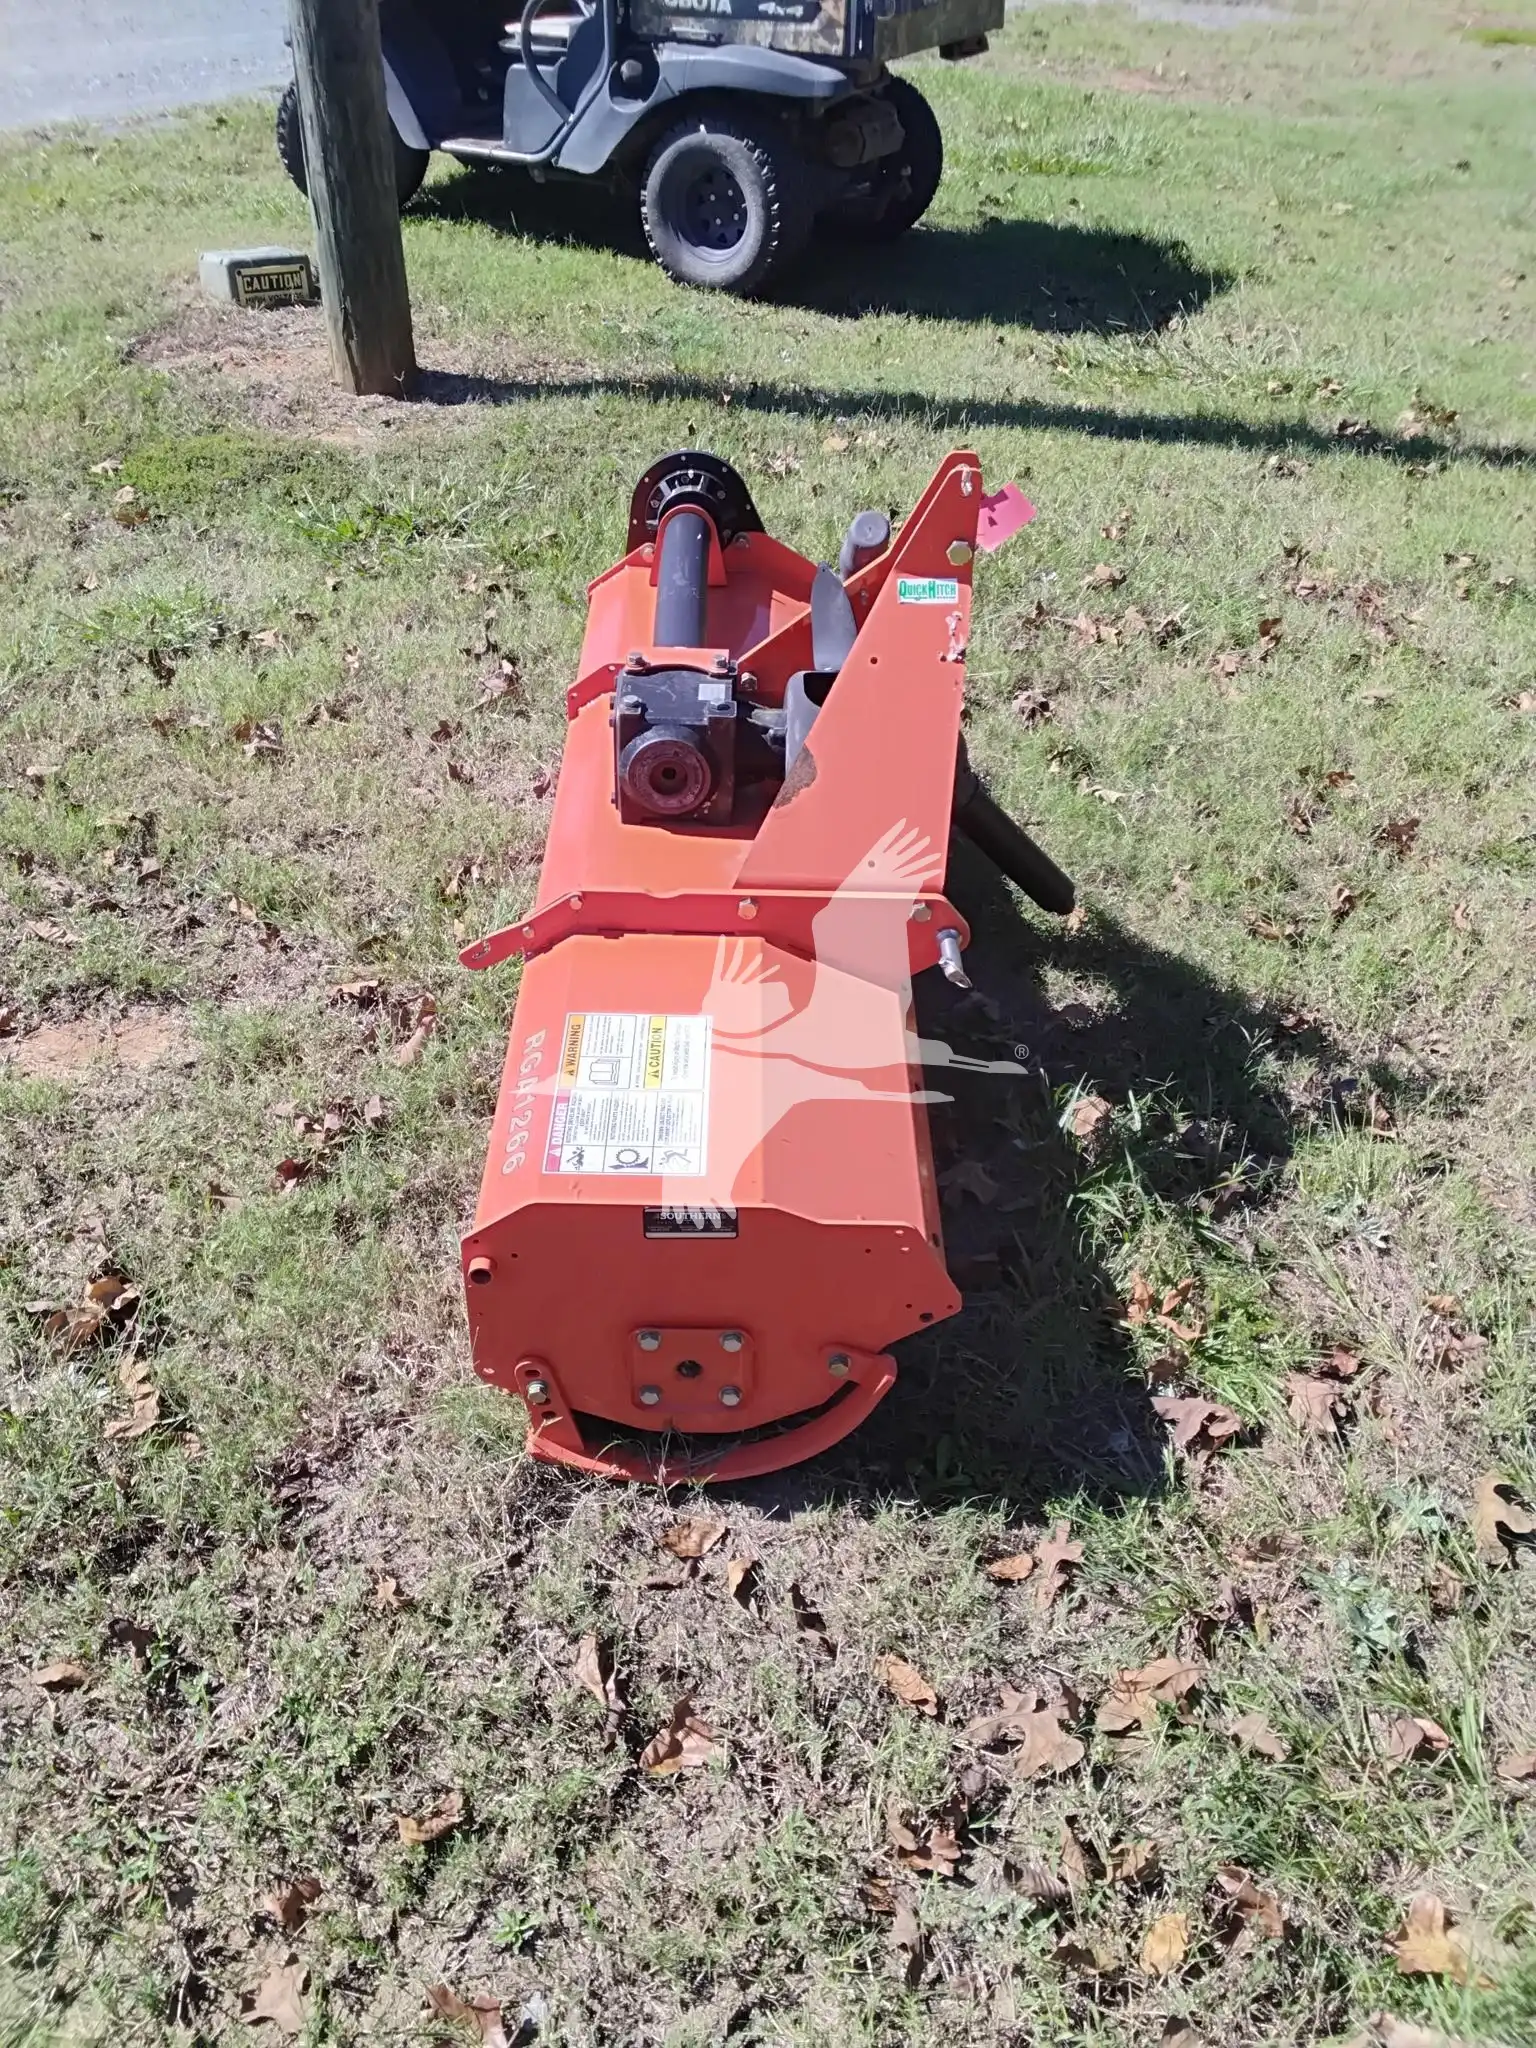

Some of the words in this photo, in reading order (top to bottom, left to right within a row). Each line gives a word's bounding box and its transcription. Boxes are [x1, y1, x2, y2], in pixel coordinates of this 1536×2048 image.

[244, 273, 302, 291] CAUTION
[565, 1023, 582, 1070] WARNING
[648, 1026, 663, 1069] CAUTION
[552, 1102, 570, 1146] DANGER
[660, 1212, 721, 1220] SOUTHERN
